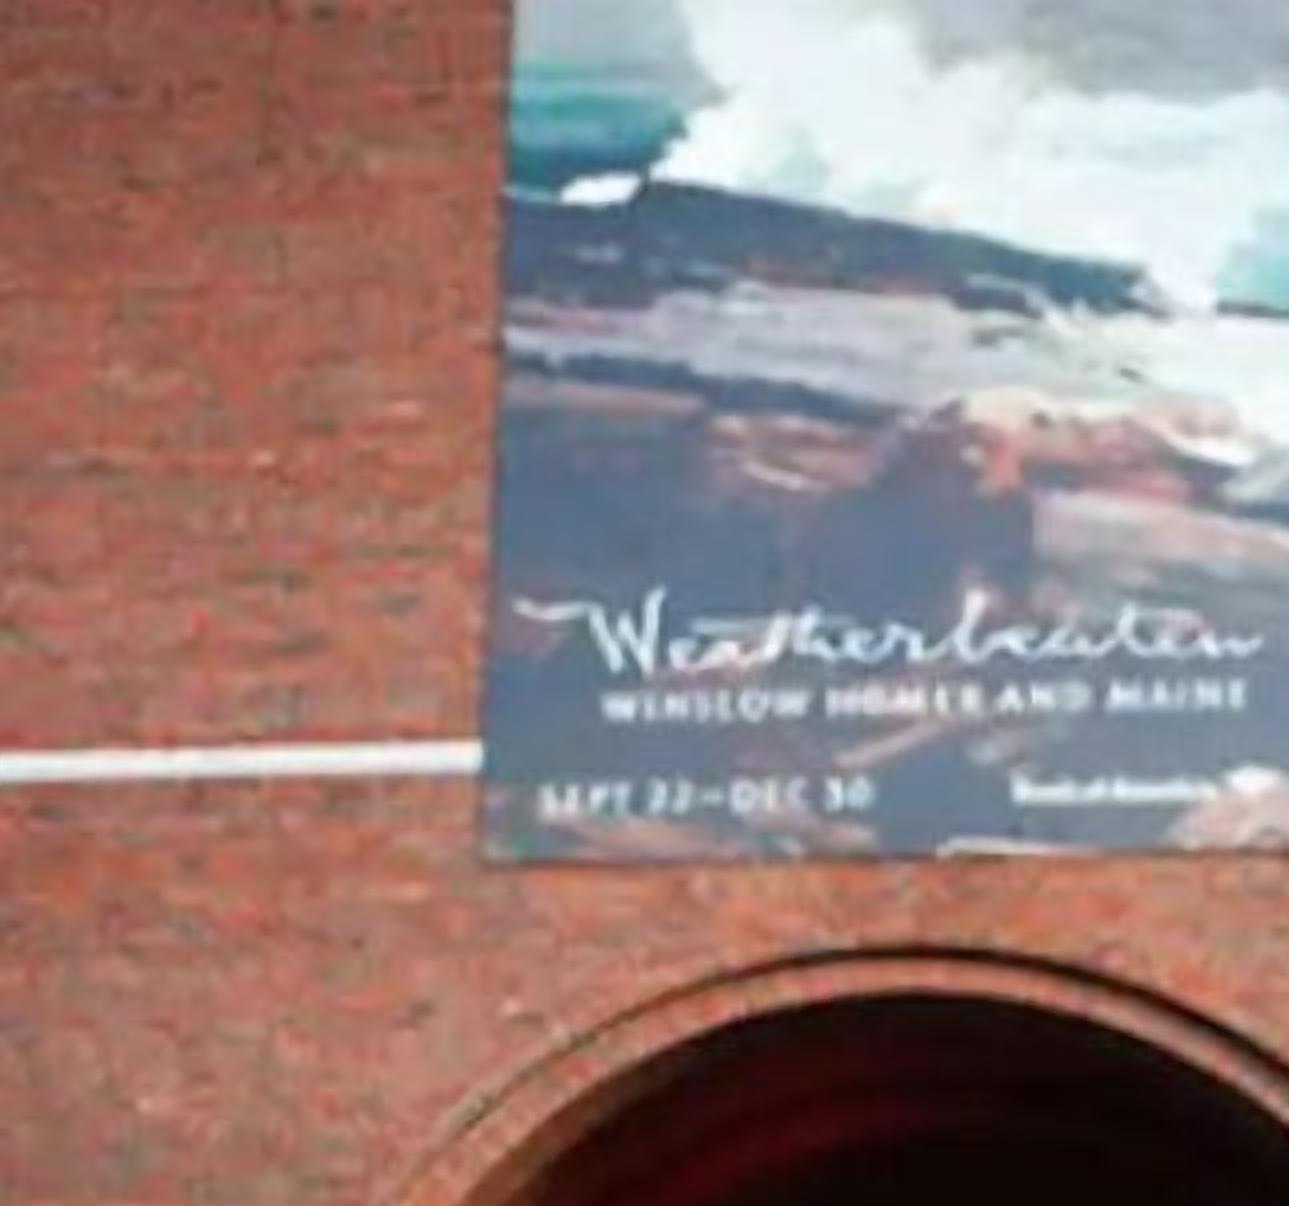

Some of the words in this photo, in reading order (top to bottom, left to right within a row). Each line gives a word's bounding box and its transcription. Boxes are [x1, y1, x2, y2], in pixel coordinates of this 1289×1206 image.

[513, 585, 1264, 676] Weatherbeaten
[602, 684, 813, 724] WINSLOW
[824, 681, 986, 721] HOMER
[1002, 679, 1091, 714] AND
[1106, 676, 1250, 712] MAINE
